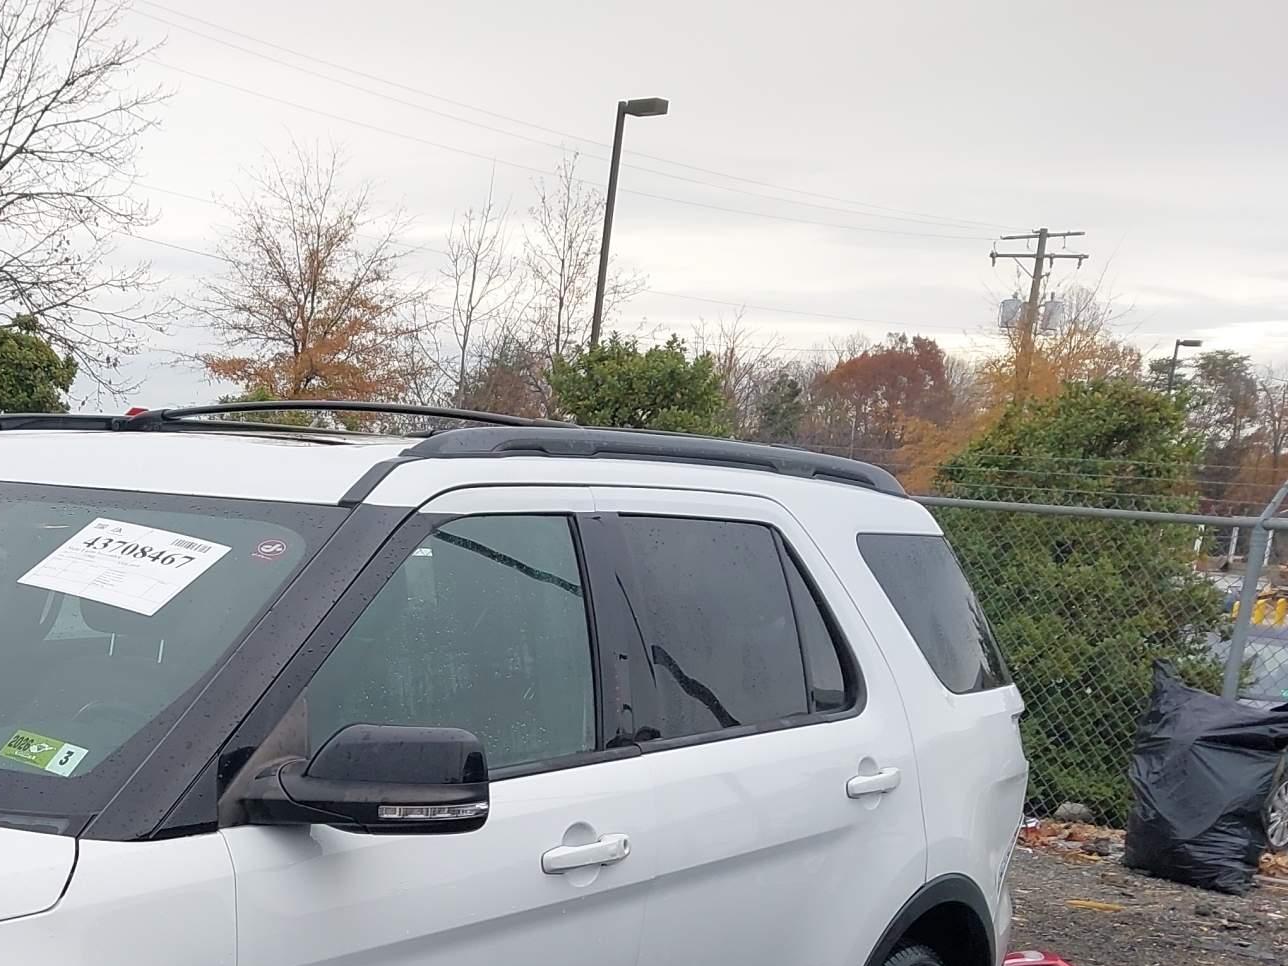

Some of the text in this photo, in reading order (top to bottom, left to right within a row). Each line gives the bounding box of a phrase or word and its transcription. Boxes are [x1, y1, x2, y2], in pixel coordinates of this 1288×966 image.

[83, 535, 196, 569] 43708467
[7, 735, 35, 752] 2026
[58, 750, 75, 766] 3
